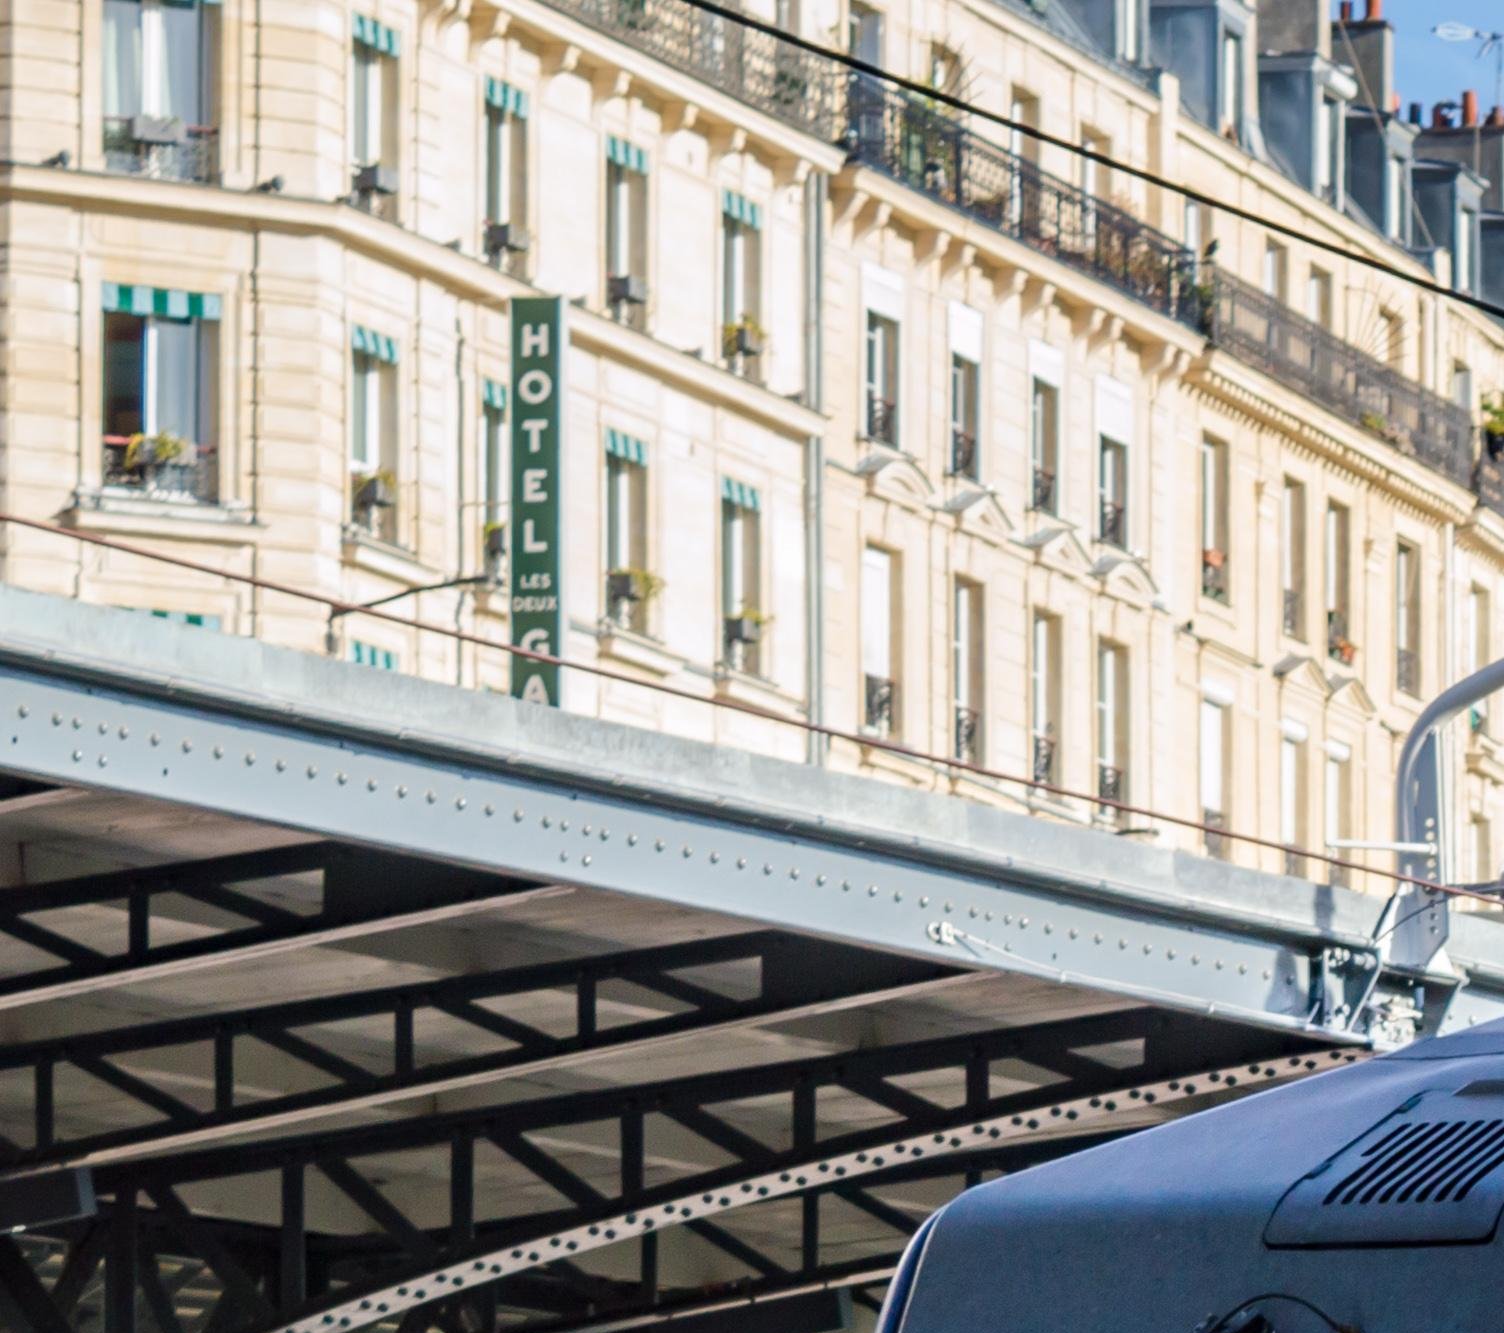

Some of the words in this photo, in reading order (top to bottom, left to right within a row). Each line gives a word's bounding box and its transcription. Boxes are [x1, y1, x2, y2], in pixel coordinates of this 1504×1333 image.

[517, 322, 553, 554] HOTEL
[519, 572, 552, 590] LES
[512, 595, 557, 612] DEUX
